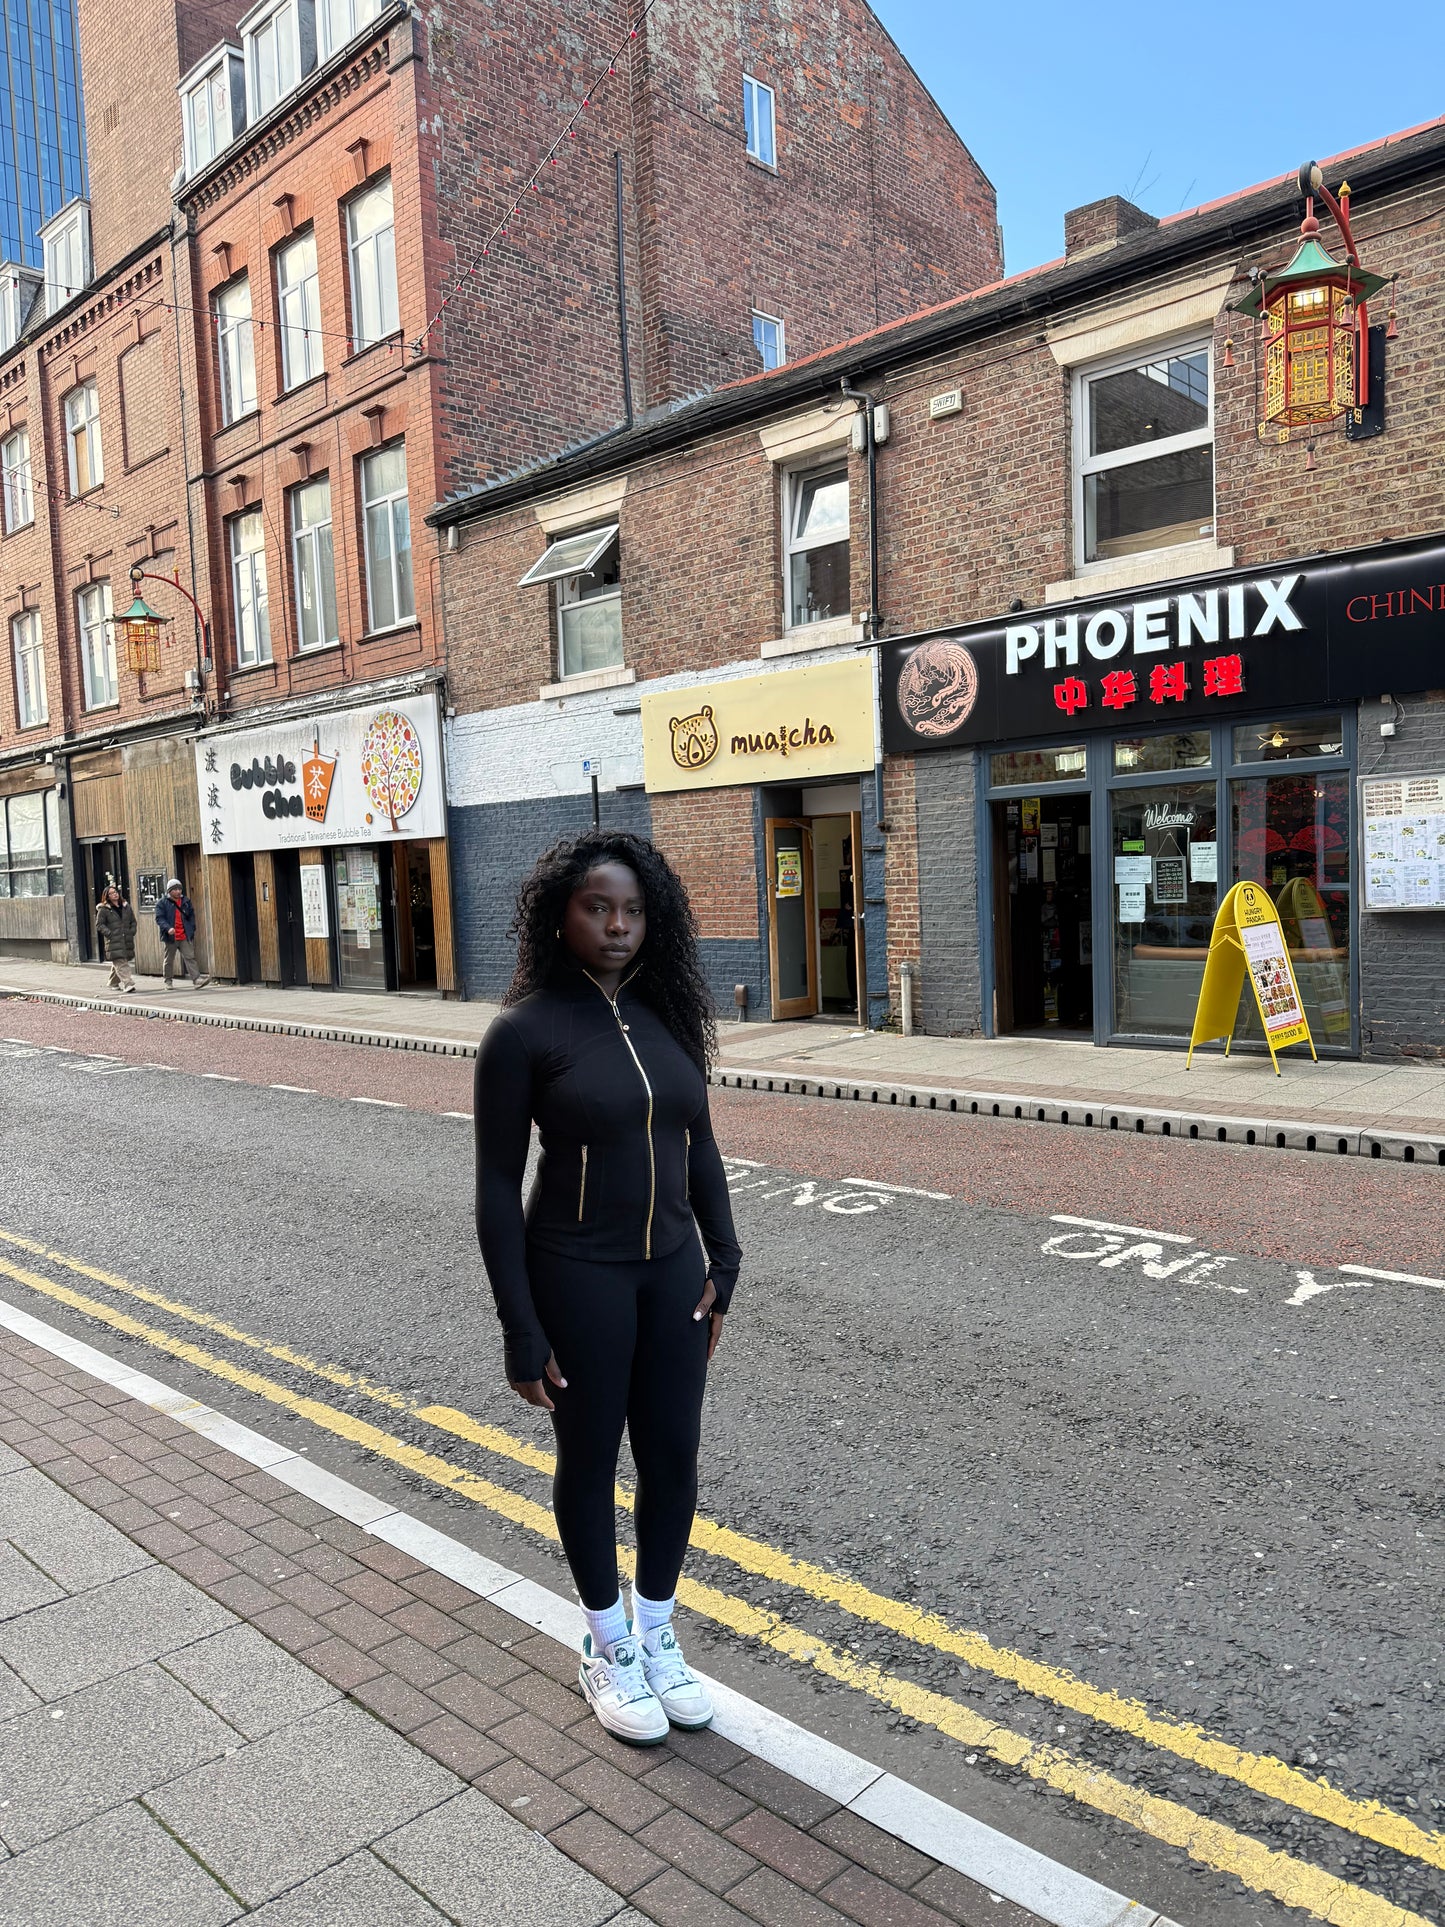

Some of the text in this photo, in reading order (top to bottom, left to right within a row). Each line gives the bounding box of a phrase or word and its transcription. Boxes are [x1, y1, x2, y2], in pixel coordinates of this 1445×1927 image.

[1004, 574, 1305, 675] PHOENIX
[1053, 653, 1246, 716] 中华料理
[230, 754, 297, 791] Bubble
[307, 765, 327, 799] 茶
[205, 747, 224, 844] 波波茶
[262, 788, 303, 820] Cha
[1144, 803, 1194, 828] Welcome
[278, 826, 372, 844] Traditional Taiwanese Bubble Tea
[1040, 1232, 1374, 1306] ONLY
